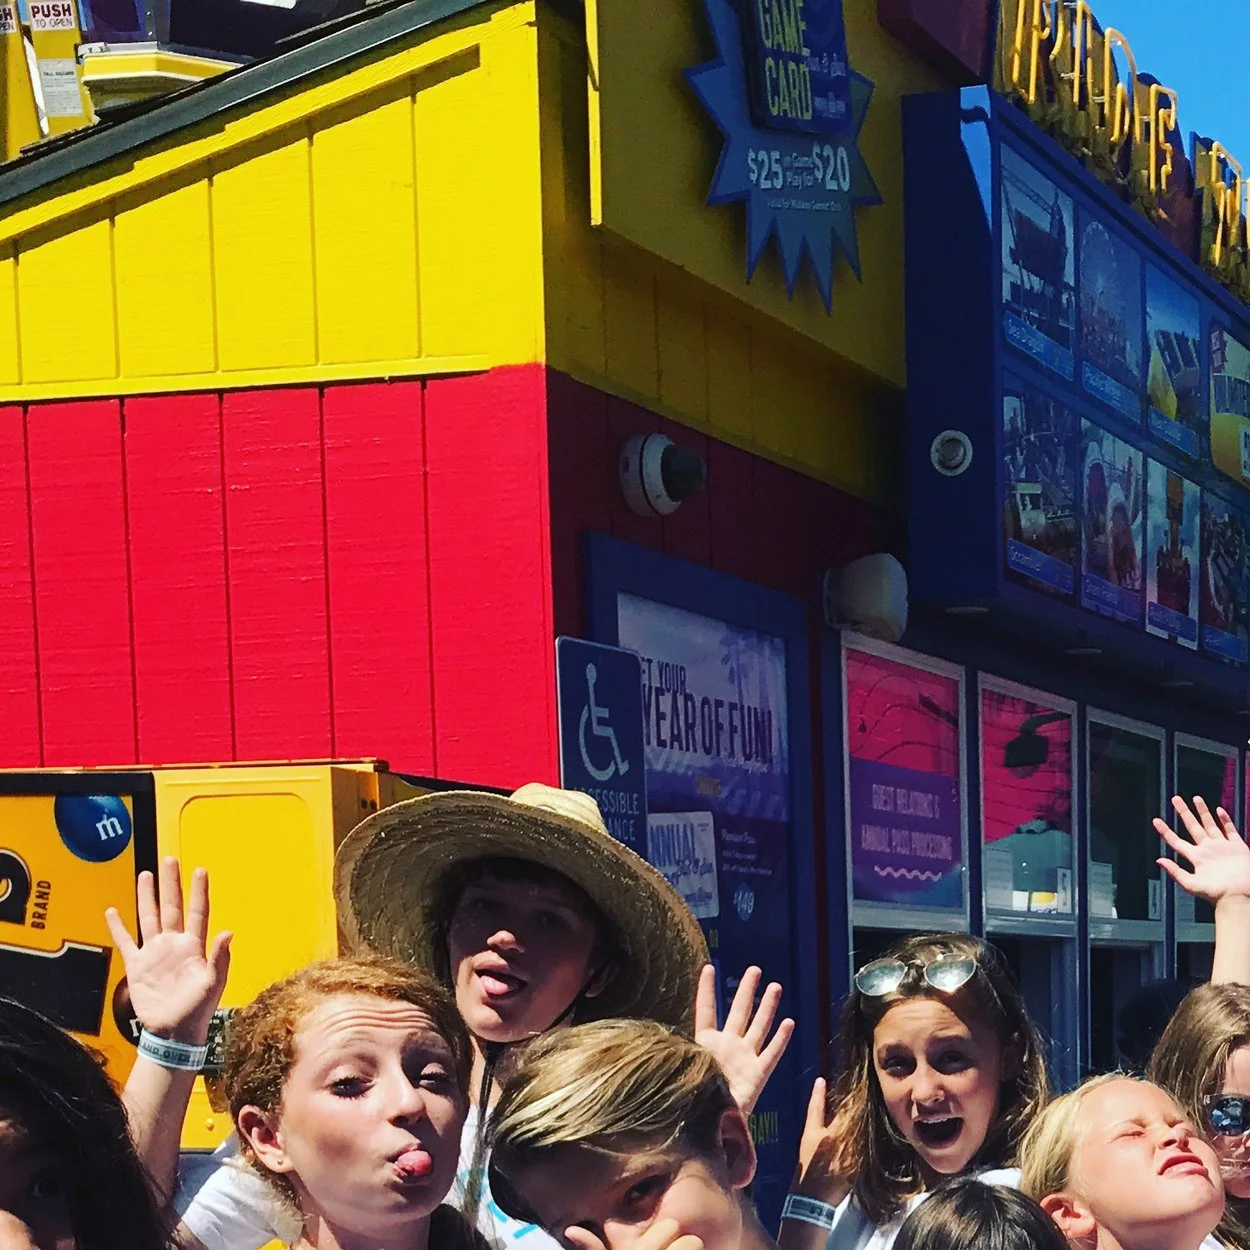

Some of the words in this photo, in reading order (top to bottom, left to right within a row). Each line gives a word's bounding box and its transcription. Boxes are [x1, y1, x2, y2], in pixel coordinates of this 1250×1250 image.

[31, 4, 72, 18] PUSH
[35, 19, 46, 28] TO
[49, 17, 73, 27] OPEN
[759, 0, 810, 56] GAME
[765, 57, 813, 120] CARD
[747, 147, 784, 190] $25
[812, 140, 850, 192] $20
[657, 660, 687, 696] YOUR
[642, 683, 698, 754] YEAR
[701, 696, 724, 757] OF
[30, 880, 52, 930] BRAND
